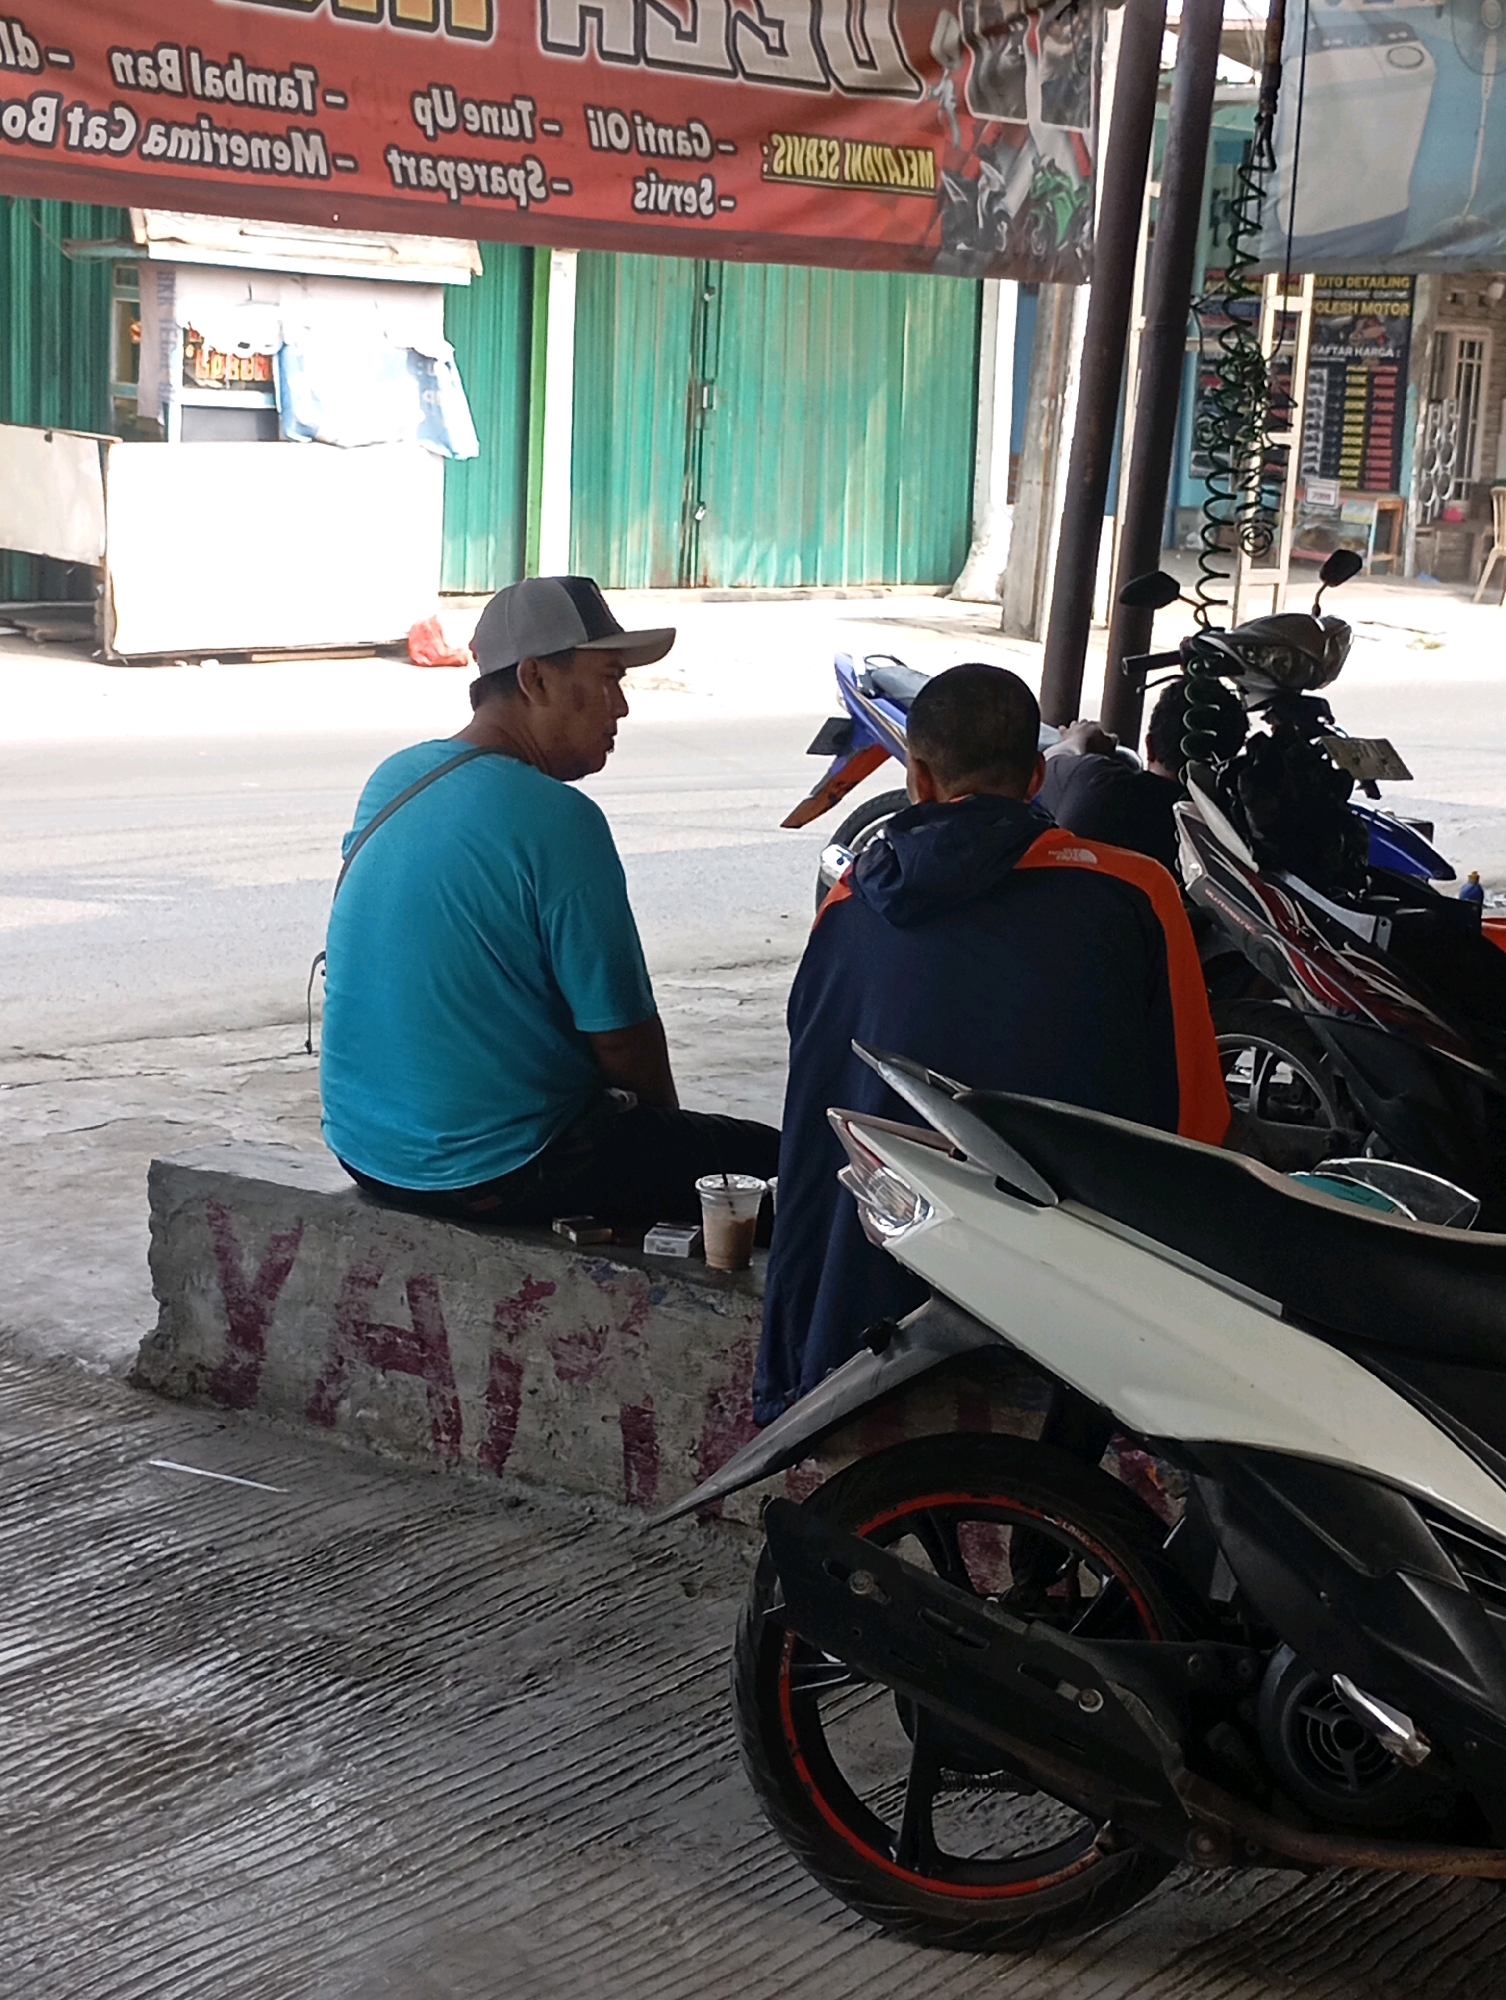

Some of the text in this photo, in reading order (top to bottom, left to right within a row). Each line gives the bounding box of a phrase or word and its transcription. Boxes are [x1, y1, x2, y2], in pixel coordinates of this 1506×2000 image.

[1313, 276, 1344, 289] AUTO
[1361, 302, 1411, 316] MOTOR
[1310, 344, 1354, 357] DAFTAR
[1354, 346, 1395, 358] HARGA
